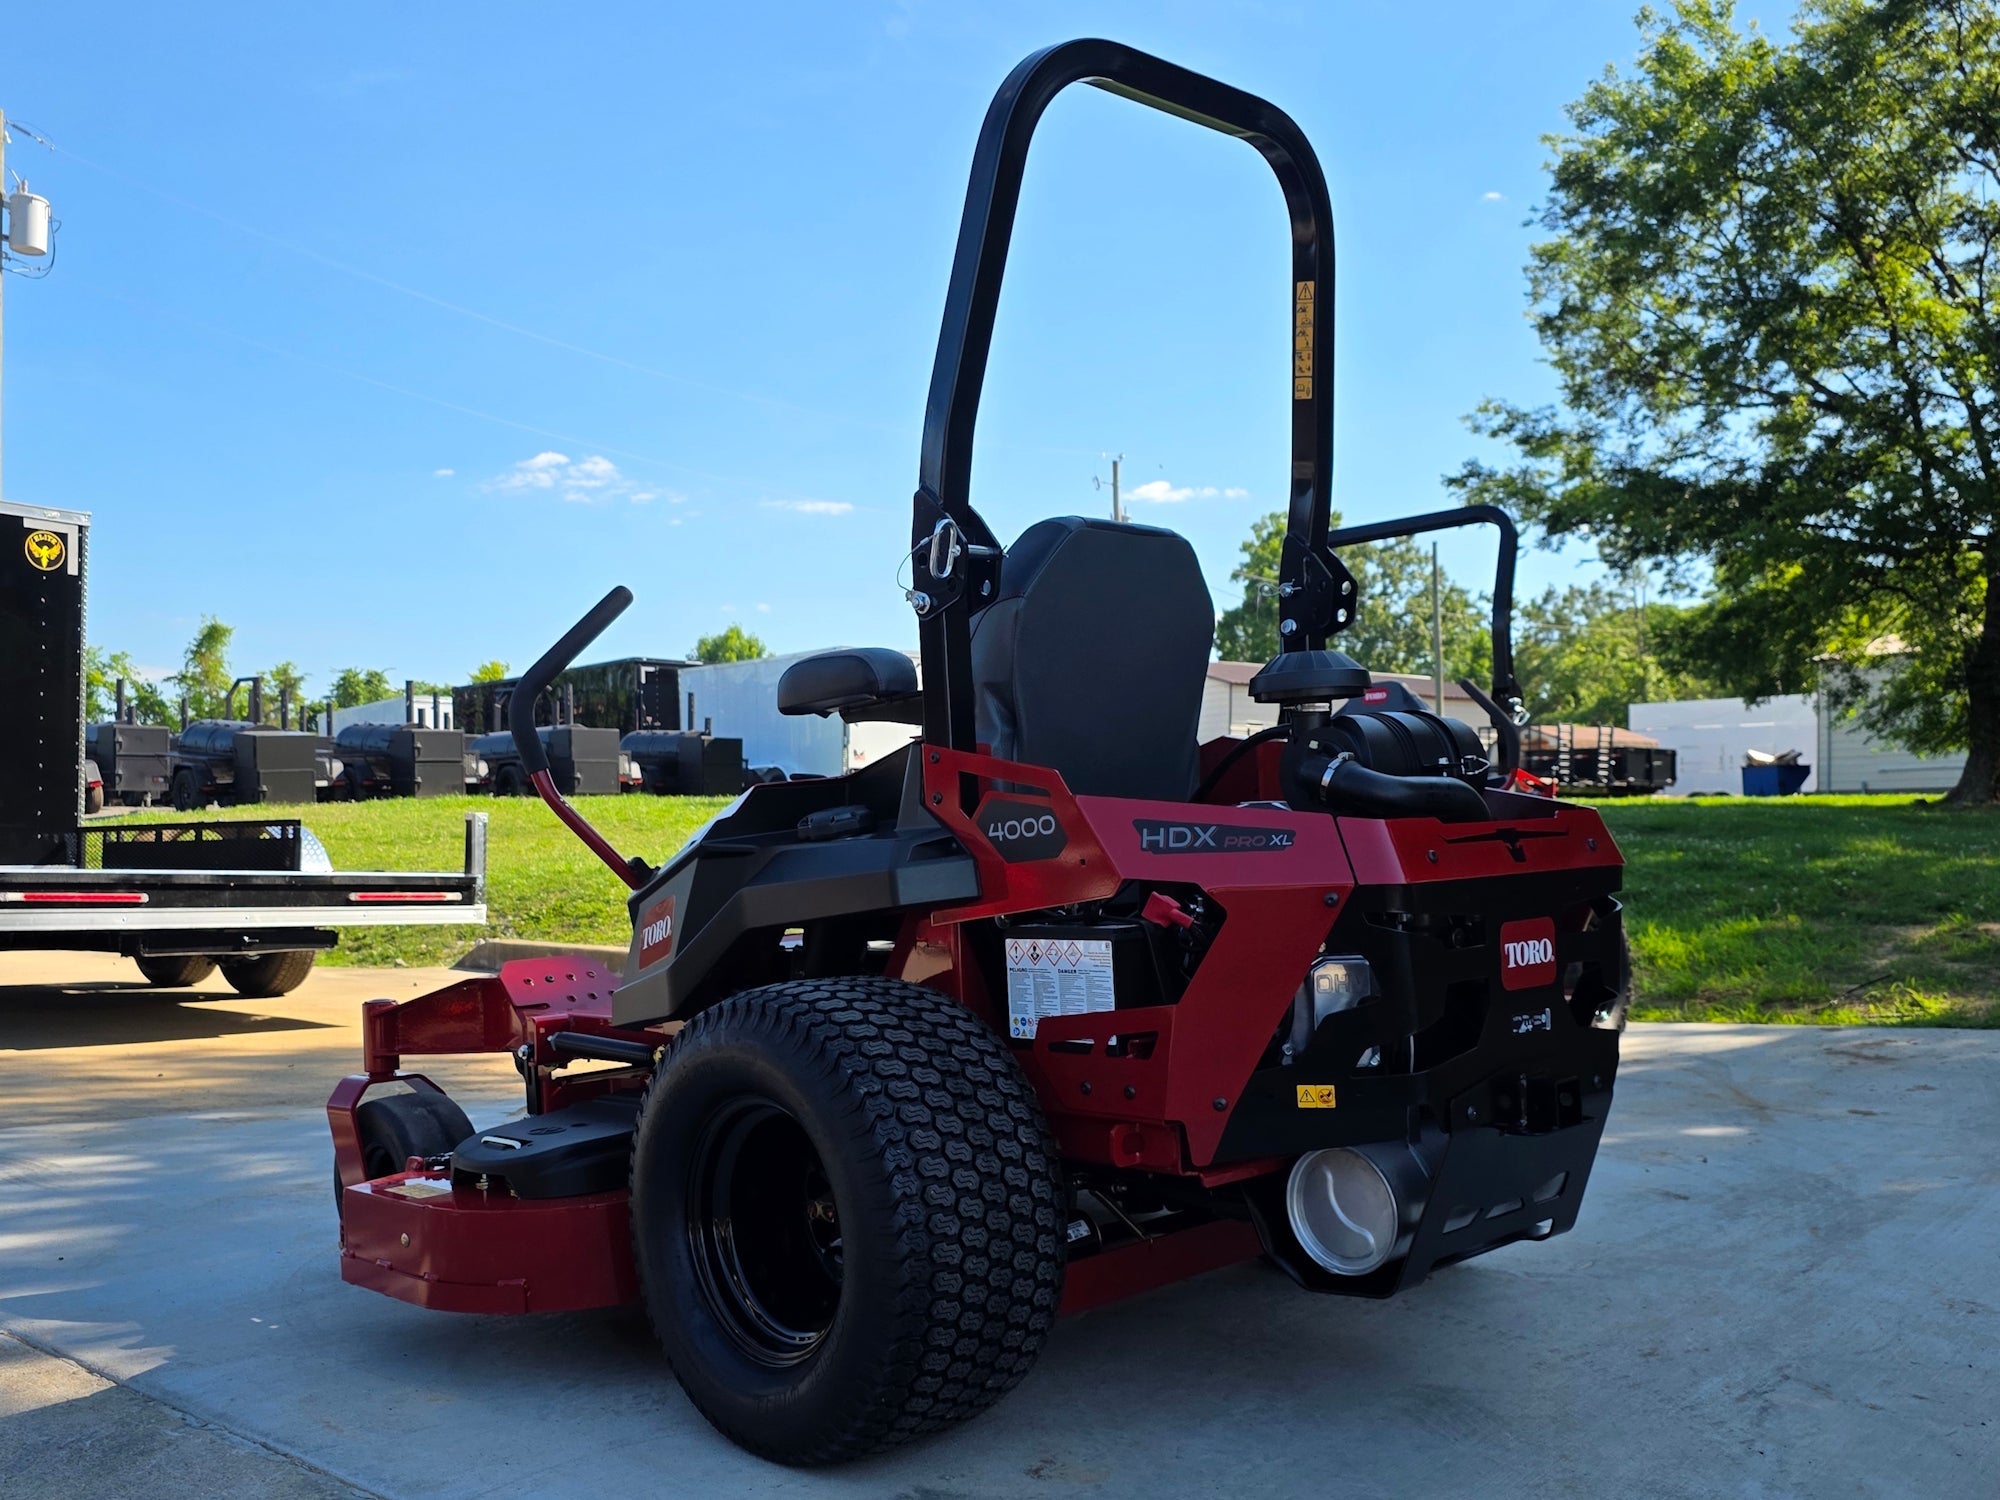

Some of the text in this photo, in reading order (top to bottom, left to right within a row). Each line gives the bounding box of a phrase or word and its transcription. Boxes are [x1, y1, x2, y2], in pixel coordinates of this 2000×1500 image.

[33, 533, 58, 545] ELITE
[988, 815, 1056, 841] 4000
[1142, 826, 1293, 848] HDX PRO XL
[642, 915, 671, 950] TORO
[1504, 938, 1553, 968] TORO
